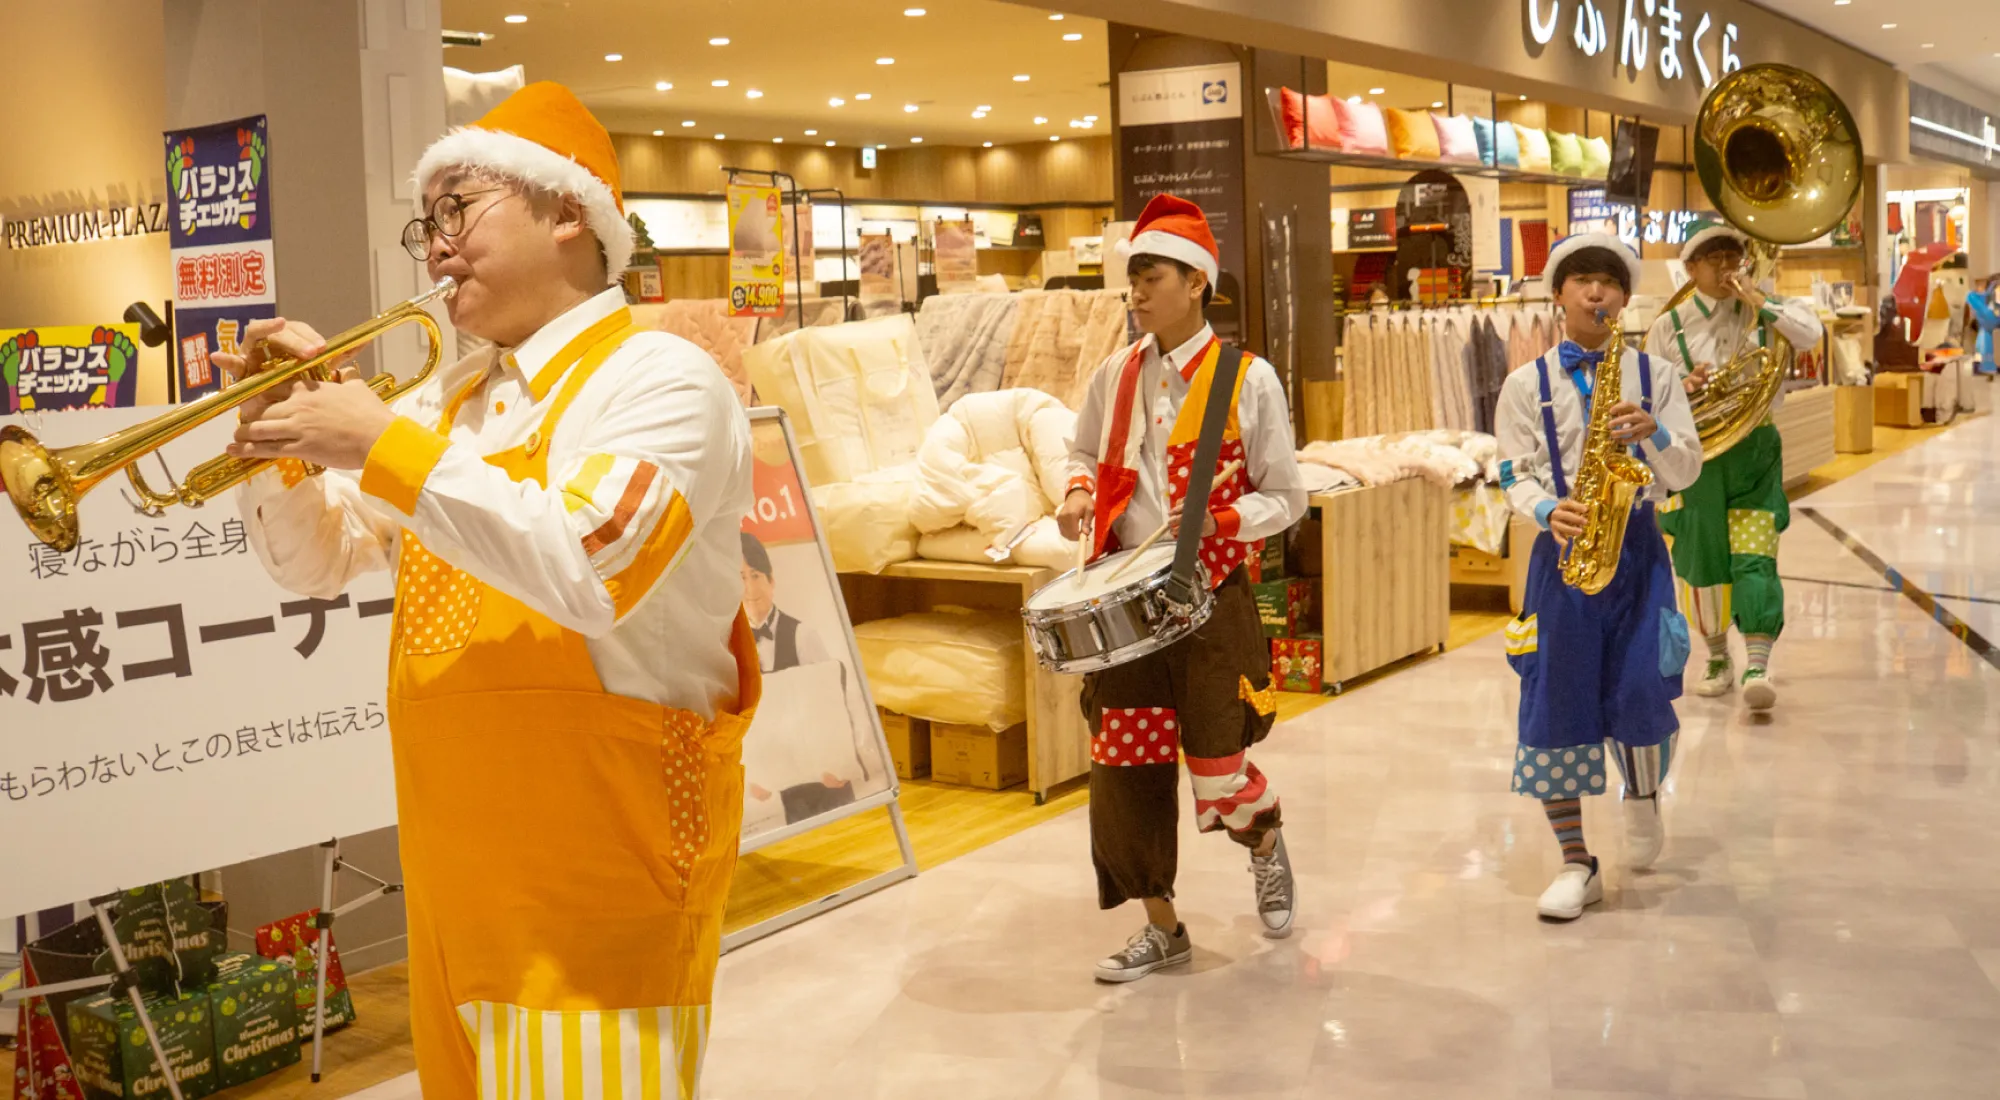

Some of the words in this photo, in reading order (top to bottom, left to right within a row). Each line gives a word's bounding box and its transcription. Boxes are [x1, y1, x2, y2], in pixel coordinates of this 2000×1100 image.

[179, 160, 254, 200] バランス
[6, 203, 169, 249] PREMIUM-PLAZ
[179, 194, 256, 232] チェッカー
[176, 251, 266, 300] 無料測定
[19, 345, 108, 372] バランス
[18, 369, 108, 395] チェッカー
[28, 517, 248, 580] 寝ながら全身
[119, 931, 209, 961] hrismas
[149, 1049, 194, 1073] Woerful
[223, 1026, 296, 1063] Christmas
[132, 1057, 211, 1096] Chritmas
